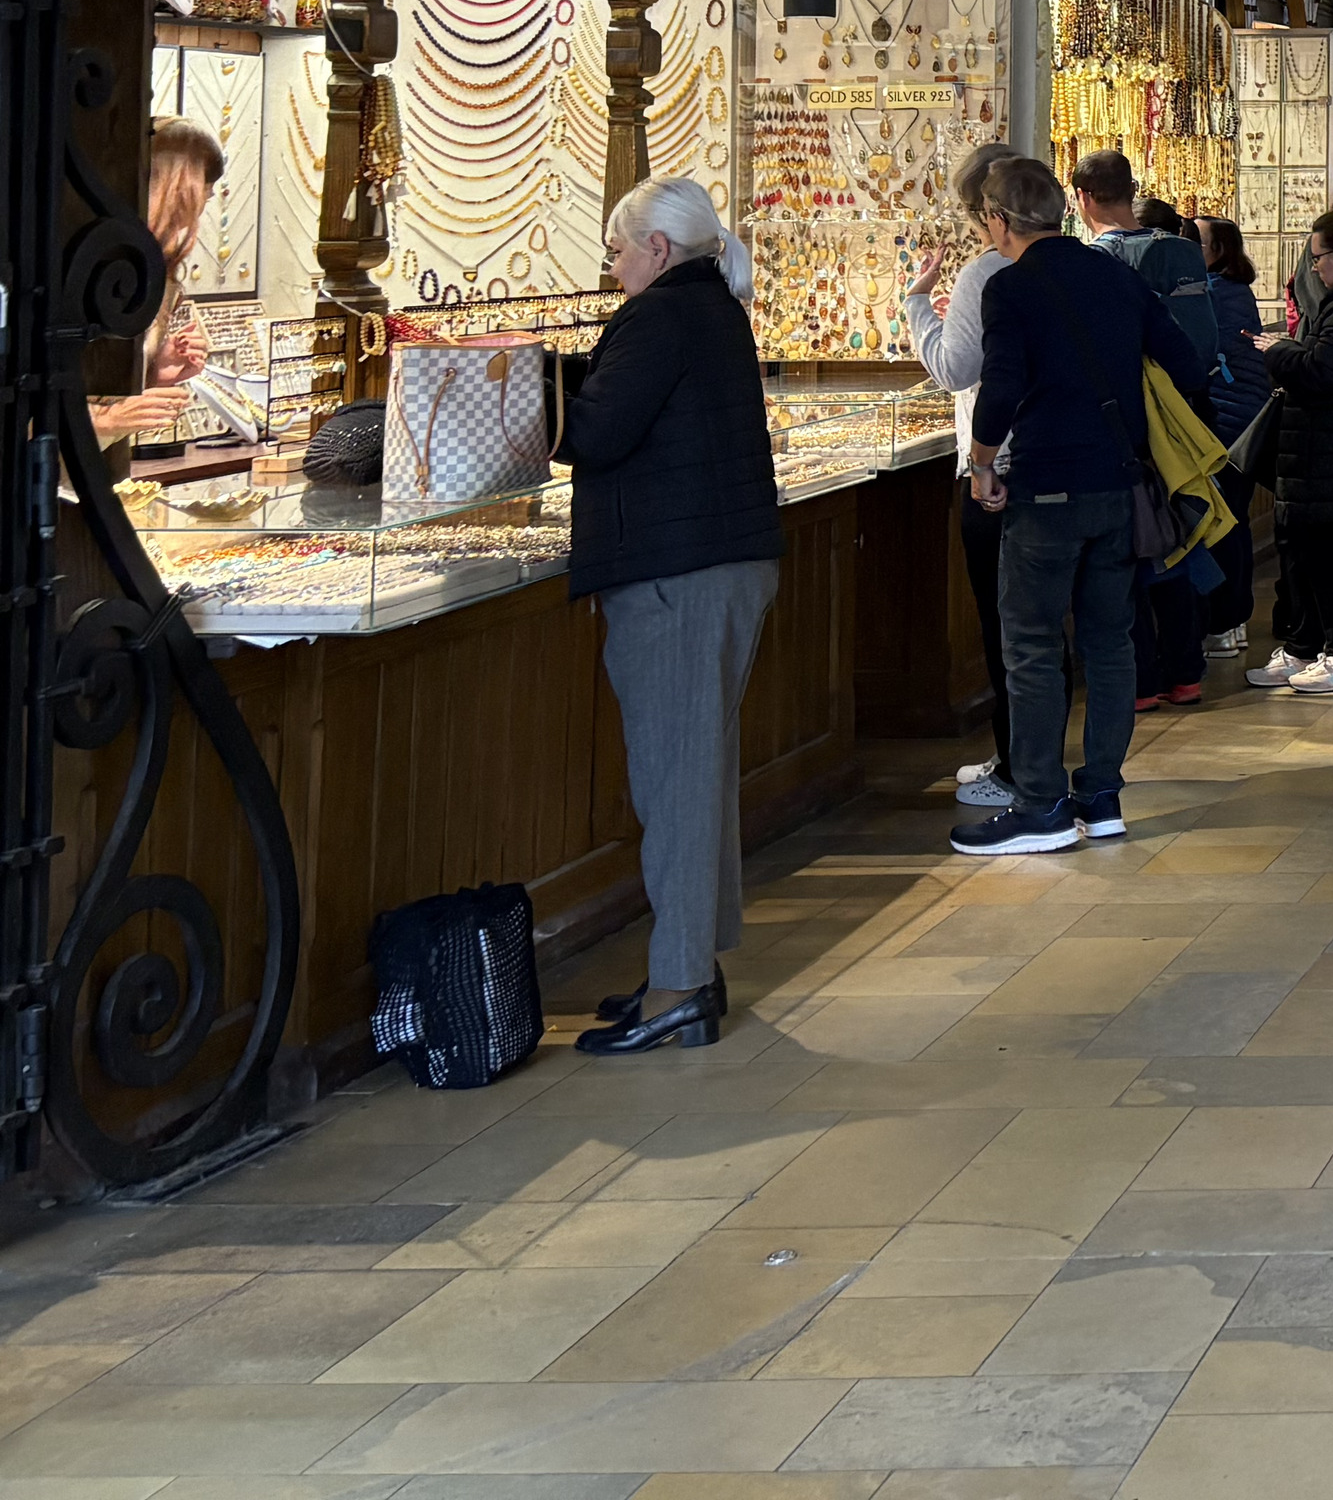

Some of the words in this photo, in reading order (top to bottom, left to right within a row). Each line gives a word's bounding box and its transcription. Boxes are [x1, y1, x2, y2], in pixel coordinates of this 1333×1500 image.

[809, 91, 847, 104] GOLD
[850, 90, 874, 104] 585
[887, 90, 927, 103] SILVER
[930, 90, 952, 102] 925
